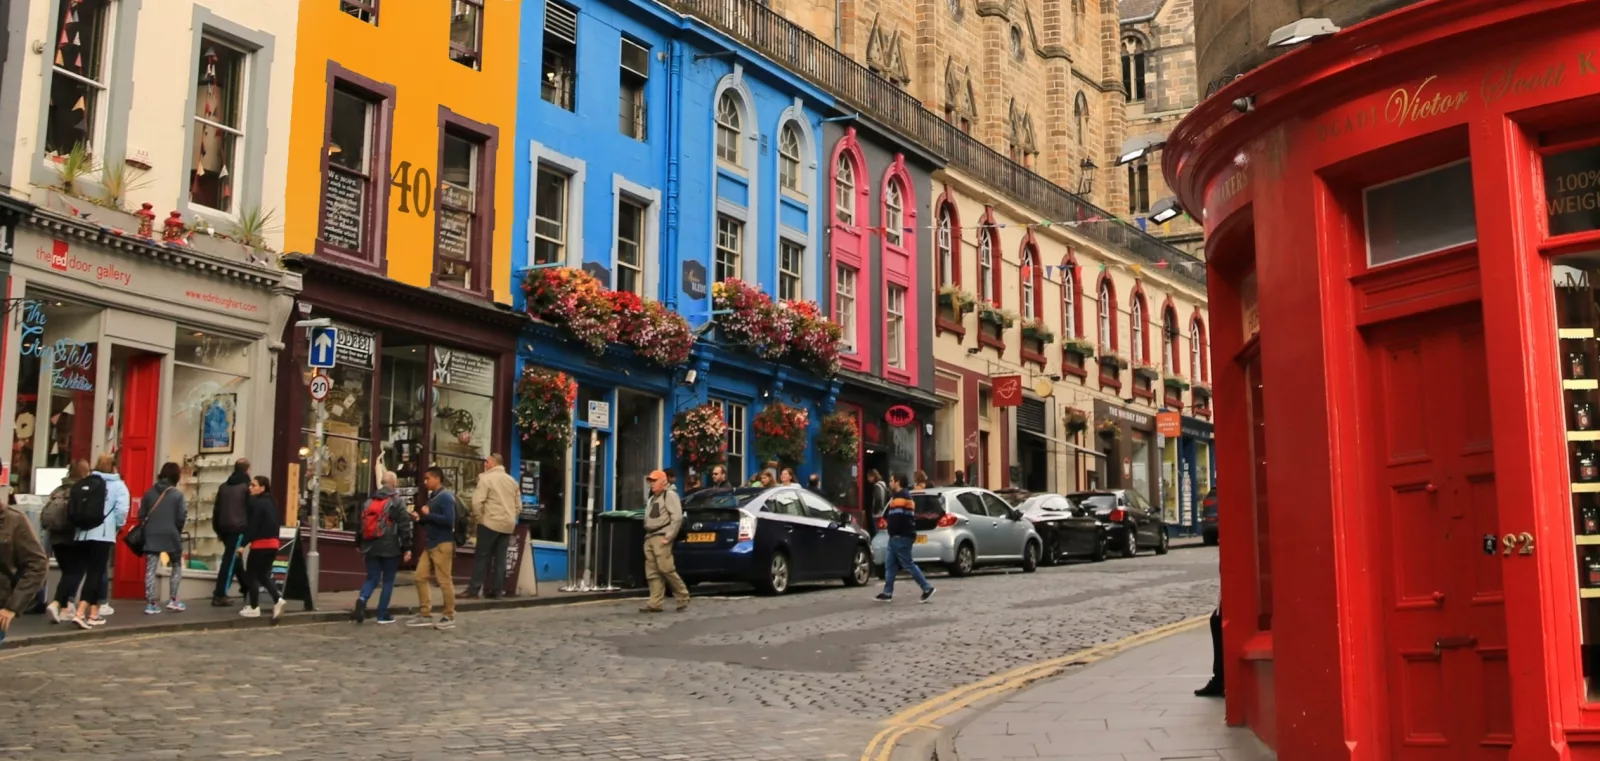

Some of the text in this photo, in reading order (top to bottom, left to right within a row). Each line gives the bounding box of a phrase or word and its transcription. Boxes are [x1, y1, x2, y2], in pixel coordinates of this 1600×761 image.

[1385, 74, 1469, 127] Victor
[1481, 56, 1566, 108] Scott
[391, 160, 432, 218] 40
[36, 246, 132, 286] the red door gallery
[185, 290, 258, 312] www.edinburghart.com
[312, 382, 327, 393] 20
[1109, 406, 1147, 425] THE WHISKY SHOP
[1502, 531, 1535, 555] 92
